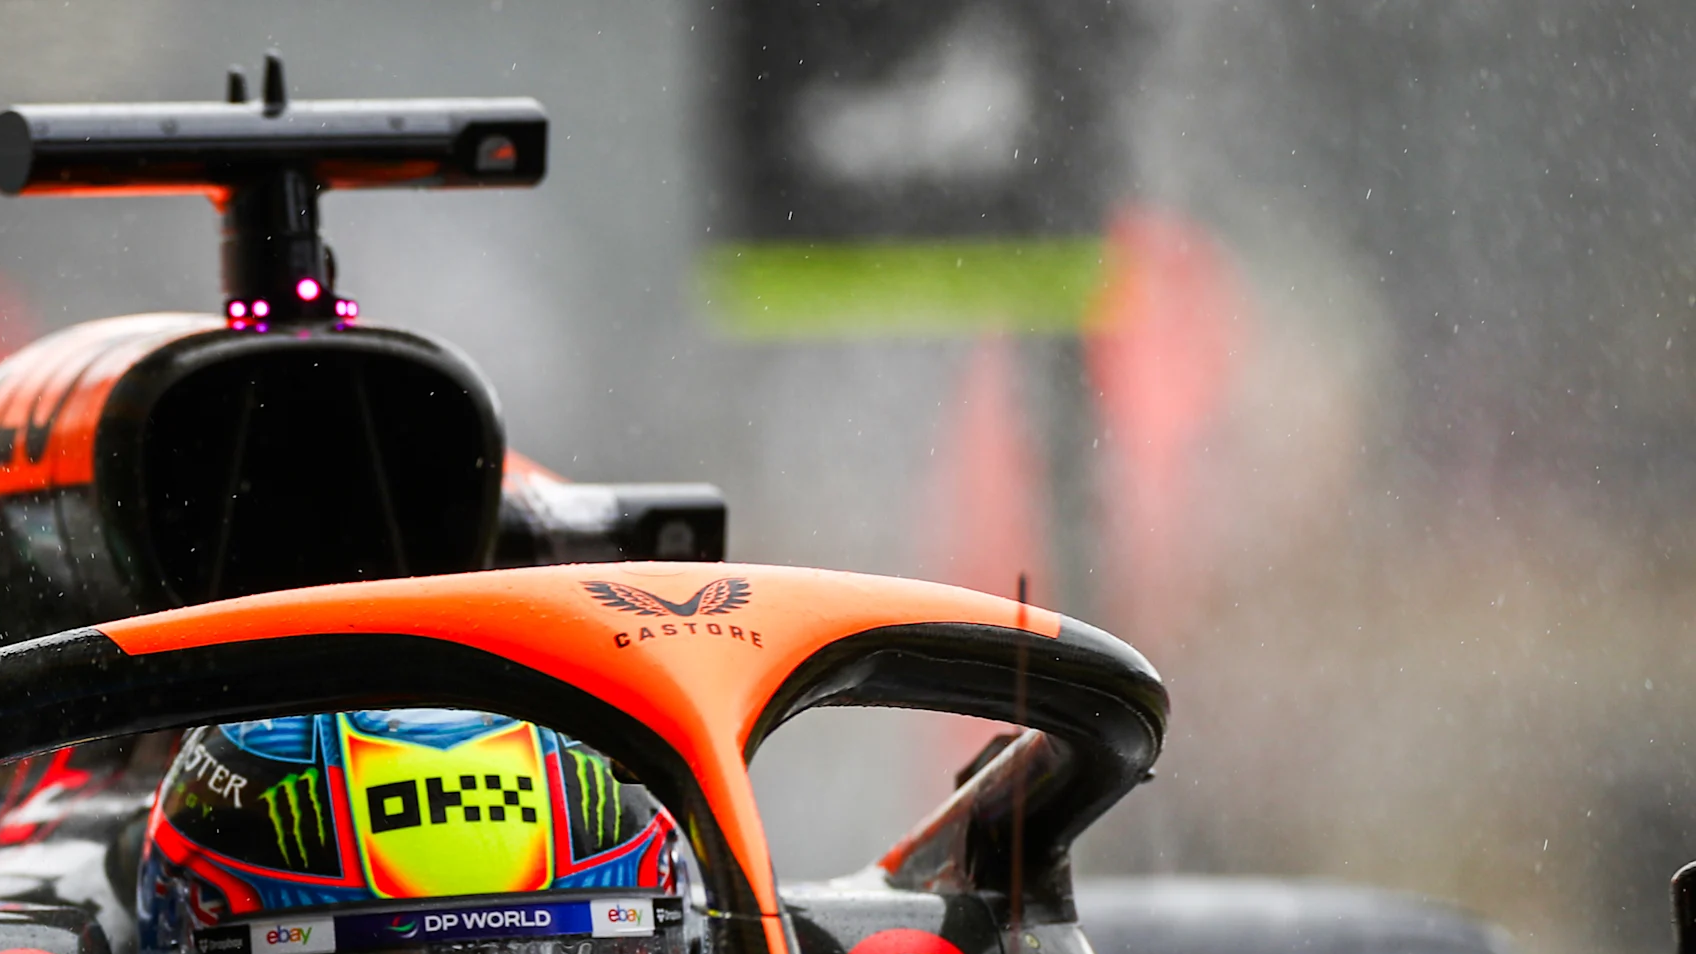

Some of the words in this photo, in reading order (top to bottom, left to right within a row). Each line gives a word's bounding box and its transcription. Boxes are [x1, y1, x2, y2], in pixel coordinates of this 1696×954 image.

[613, 621, 764, 649] CASTORE
[366, 775, 537, 835] OKX
[425, 914, 459, 932] DP
[462, 910, 551, 929] WORLD
[608, 904, 643, 926] ebay
[266, 925, 312, 945] ebay
